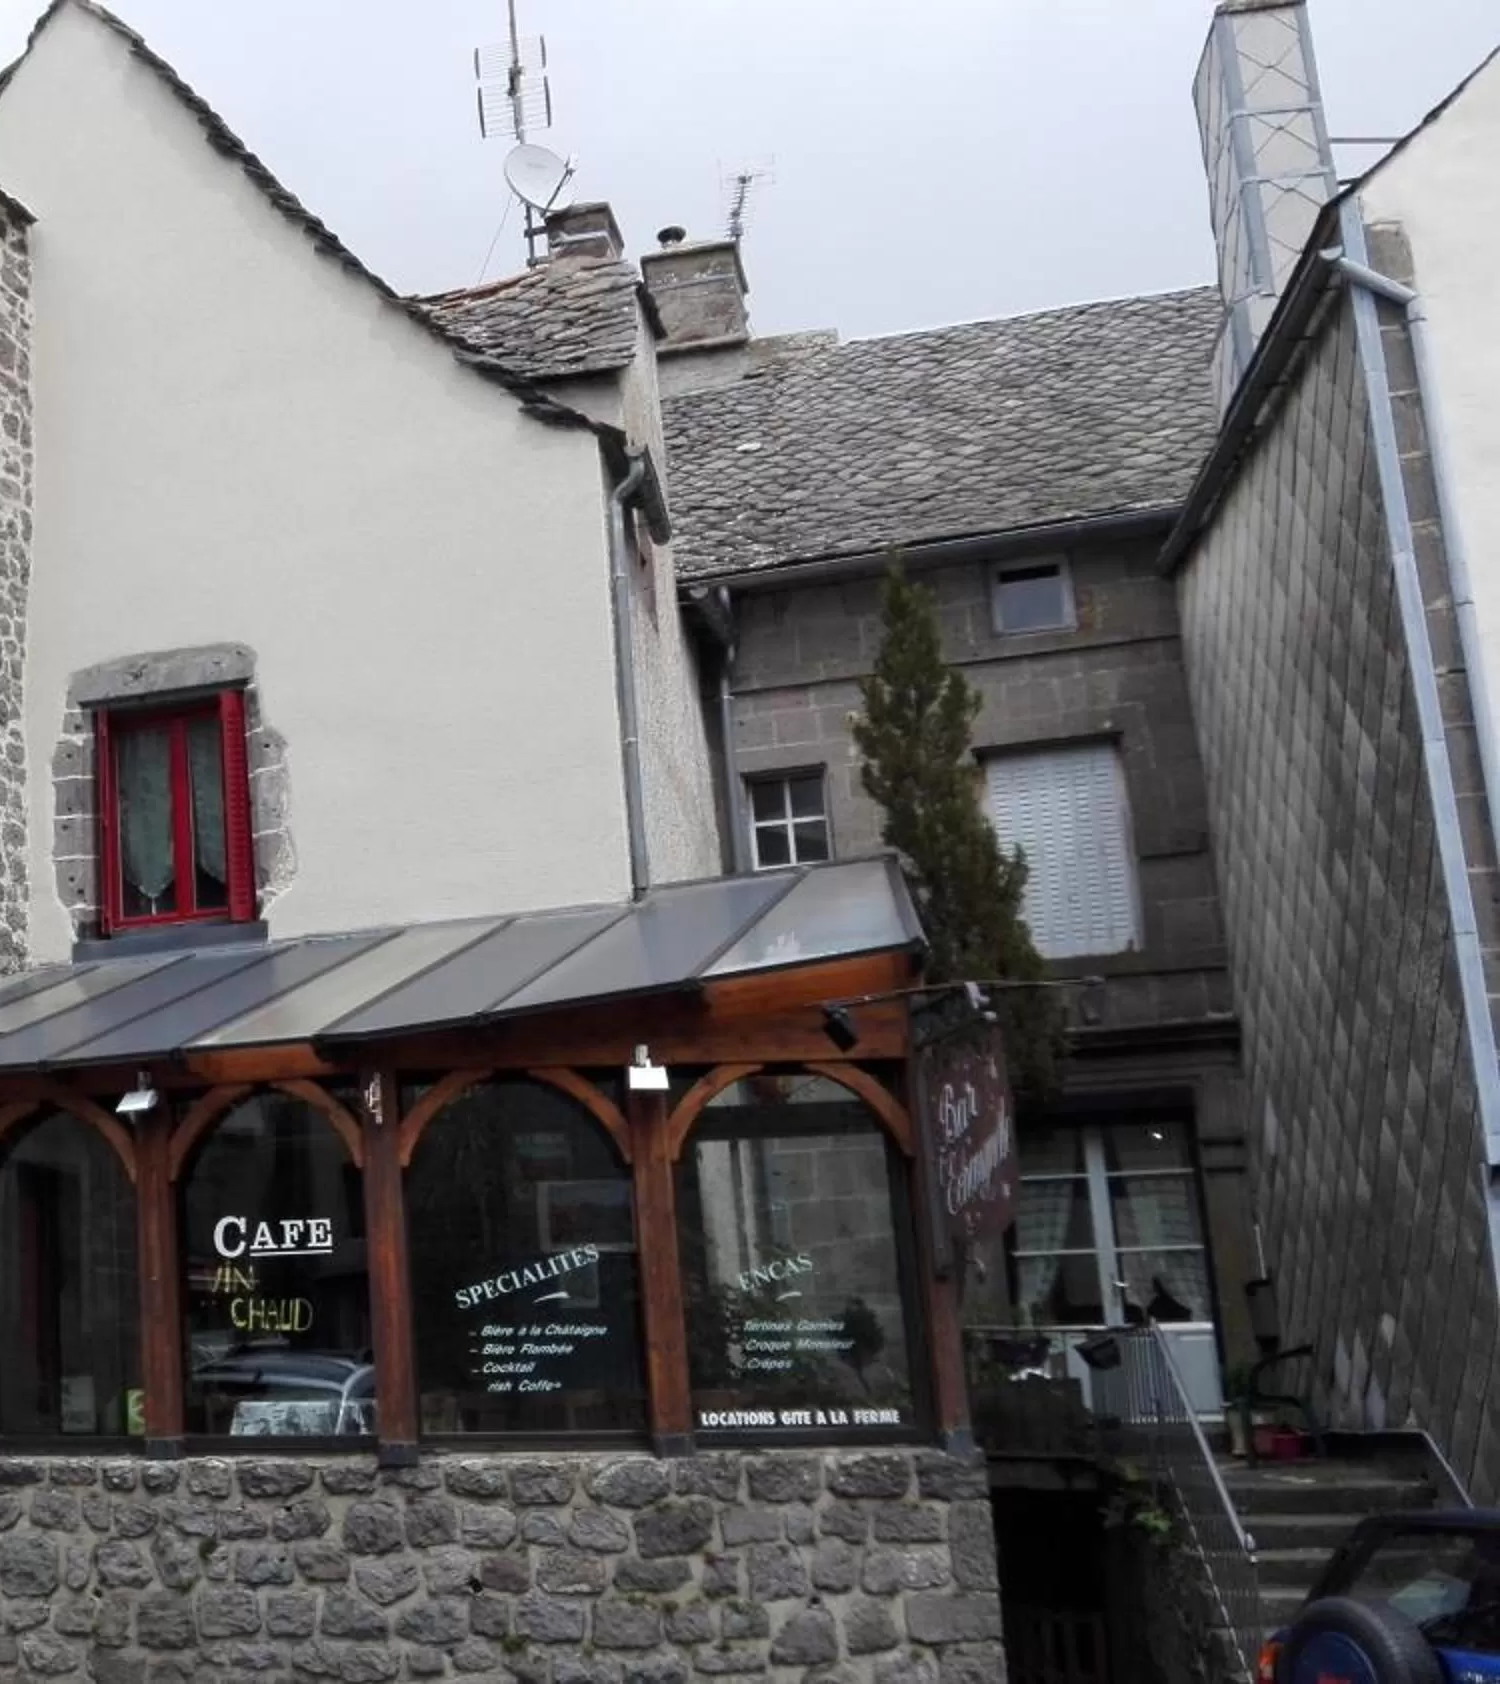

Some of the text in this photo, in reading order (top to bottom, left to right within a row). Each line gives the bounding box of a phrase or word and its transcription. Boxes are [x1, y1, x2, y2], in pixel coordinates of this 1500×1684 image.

[213, 1215, 333, 1258] CAFE
[455, 1243, 599, 1310] SPECIALITES
[739, 1253, 813, 1292] ENCAS
[230, 1297, 315, 1332] CHAUD
[482, 1361, 536, 1373] Cocktail
[701, 1409, 900, 1426] LOCATIONS GITE A LA FERME
